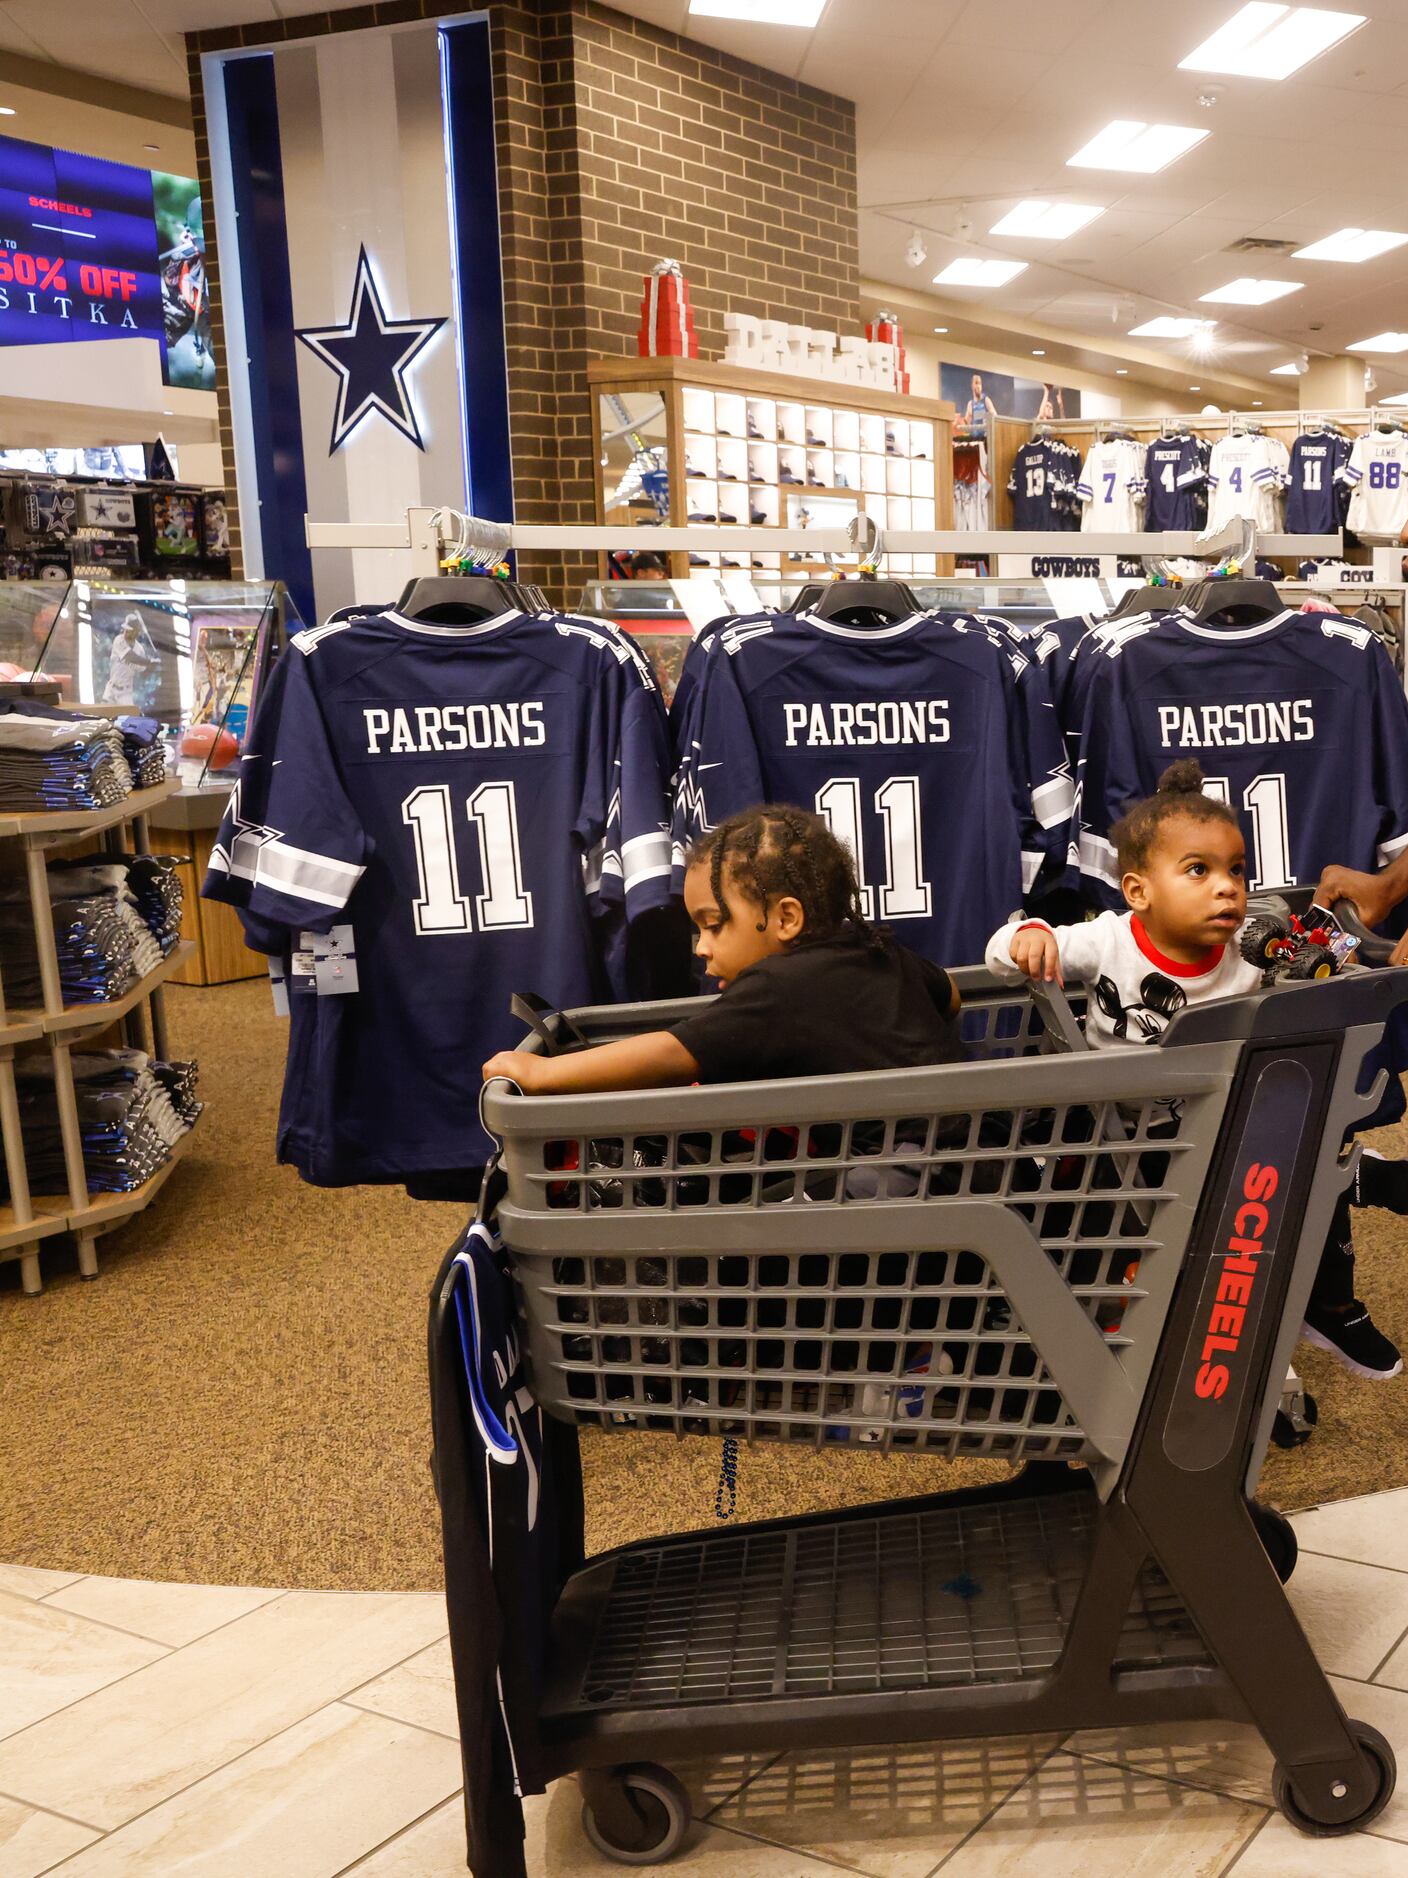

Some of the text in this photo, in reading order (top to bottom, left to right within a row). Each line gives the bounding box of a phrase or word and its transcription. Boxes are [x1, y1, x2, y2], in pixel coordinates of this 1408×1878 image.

[28, 195, 93, 219] SCHEELS
[4, 239, 17, 250] TO
[80, 264, 137, 302] OFF
[1025, 468, 1046, 498] 13
[1103, 473, 1116, 503] 7
[1160, 463, 1175, 493] 4
[1229, 467, 1242, 493] 4
[1303, 460, 1322, 491] 11
[1369, 461, 1402, 489] 88
[1031, 556, 1101, 578] COWBOYS
[363, 701, 546, 754] PARSONS
[783, 700, 951, 747] PARSONS
[1158, 699, 1315, 748] PARSONS
[1201, 773, 1297, 892] 1
[401, 781, 535, 936] 11
[1195, 1162, 1279, 1400] SCHEELS
